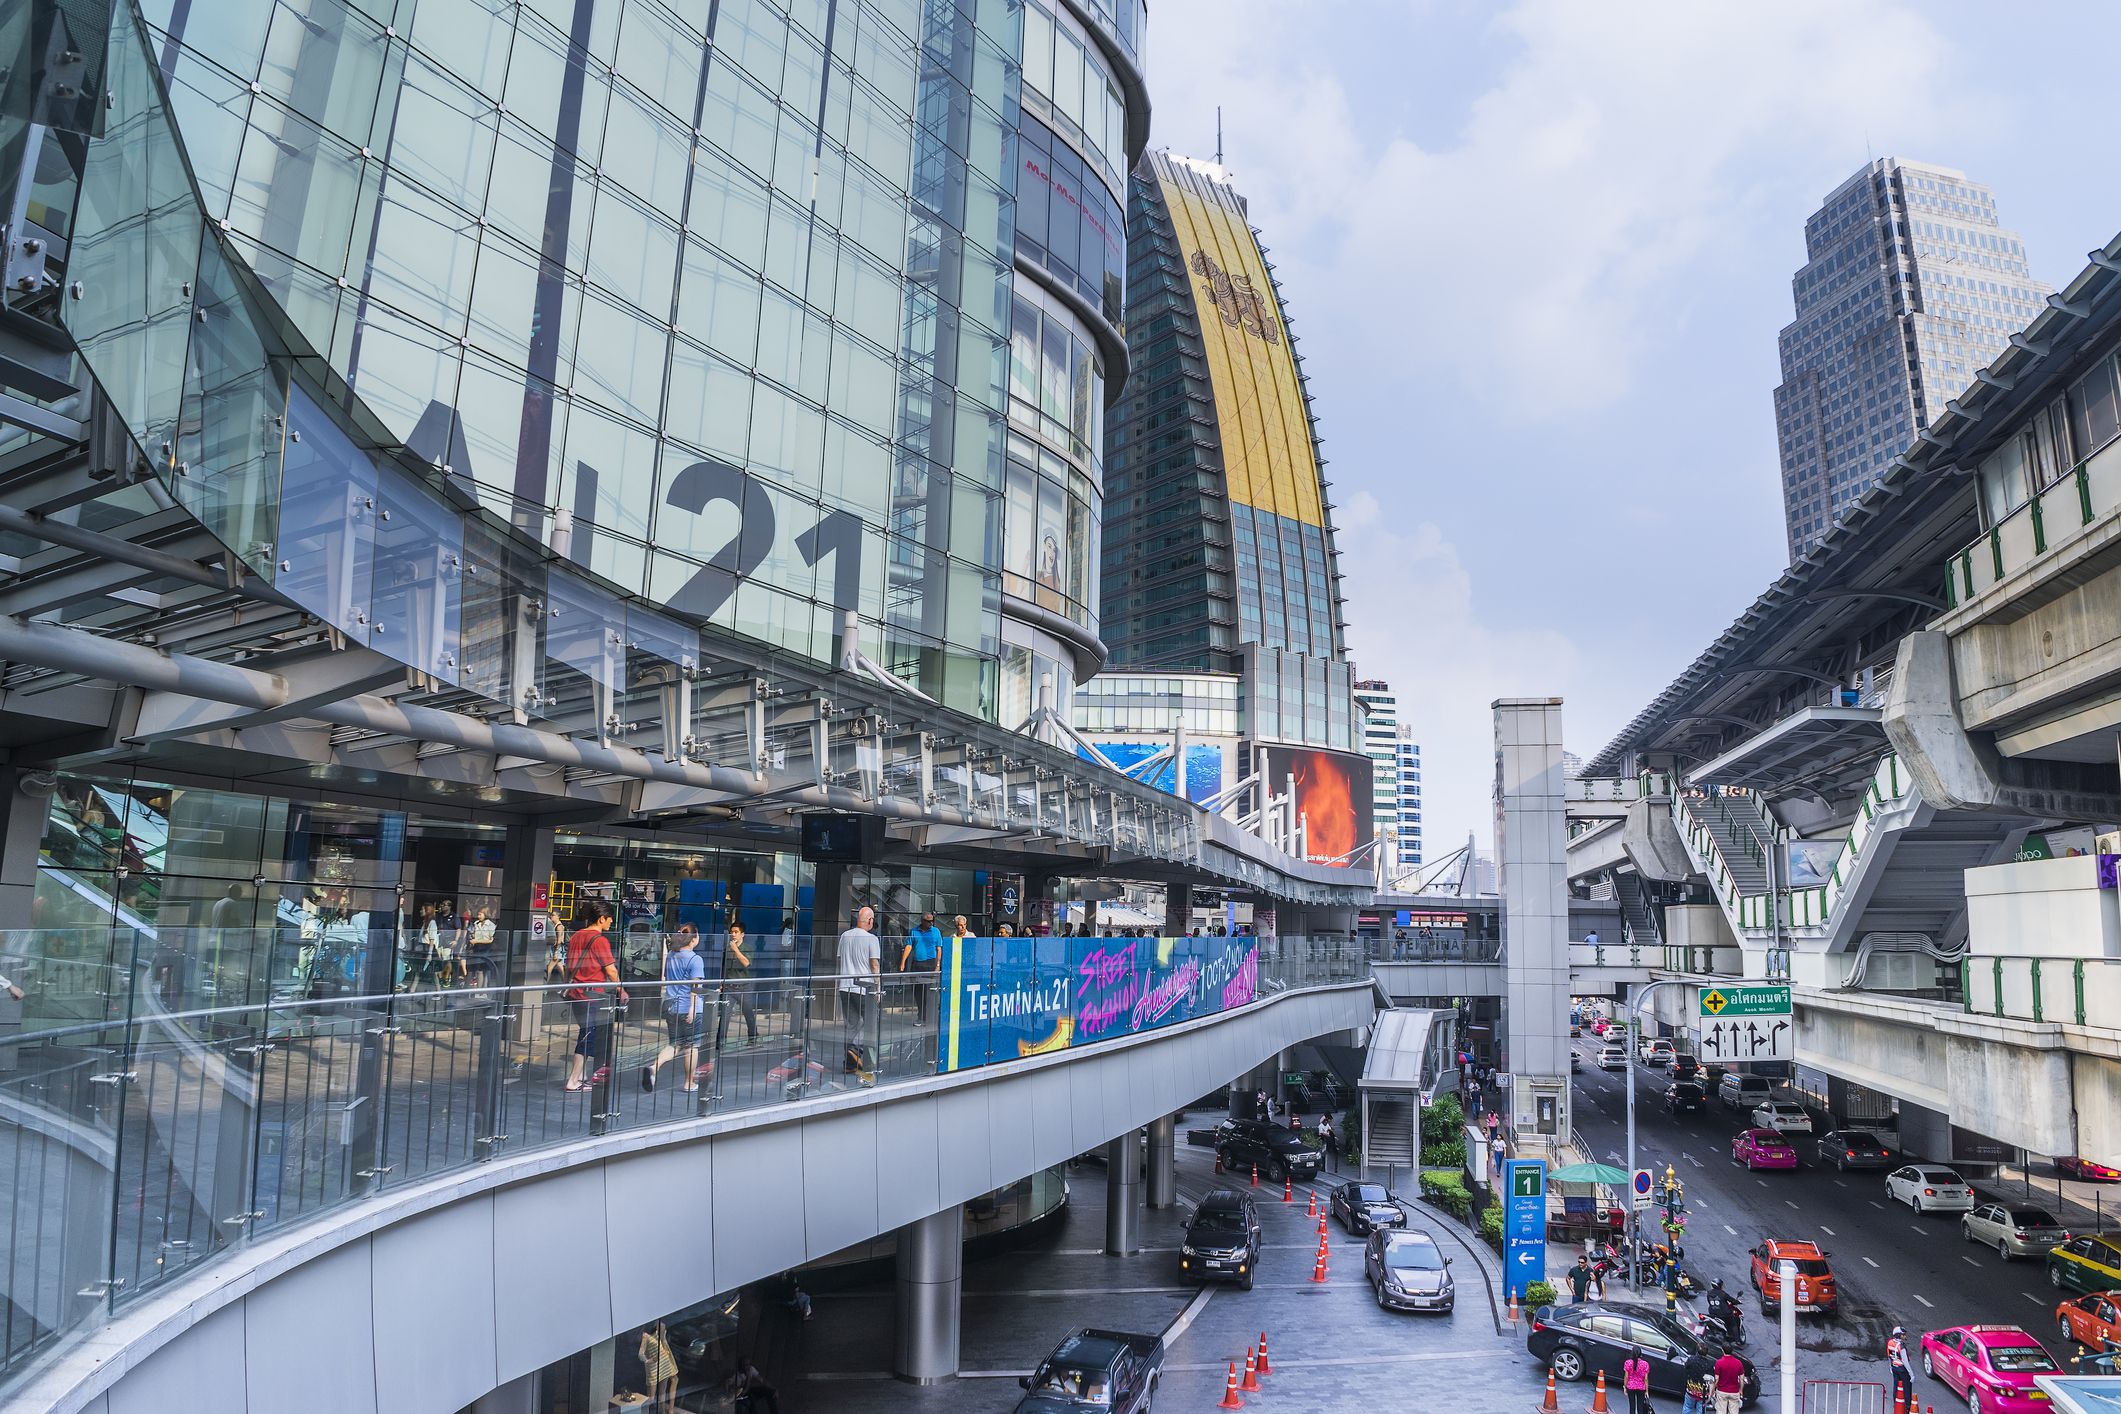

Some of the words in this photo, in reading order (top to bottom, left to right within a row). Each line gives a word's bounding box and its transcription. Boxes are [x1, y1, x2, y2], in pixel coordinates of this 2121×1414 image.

[1078, 941, 1137, 999] STREET
[1206, 957, 1223, 990] OCT
[1080, 972, 1139, 1038] FASHION
[1730, 989, 1788, 1005] อโศกมนตรี
[1523, 1176, 1531, 1194] 1
